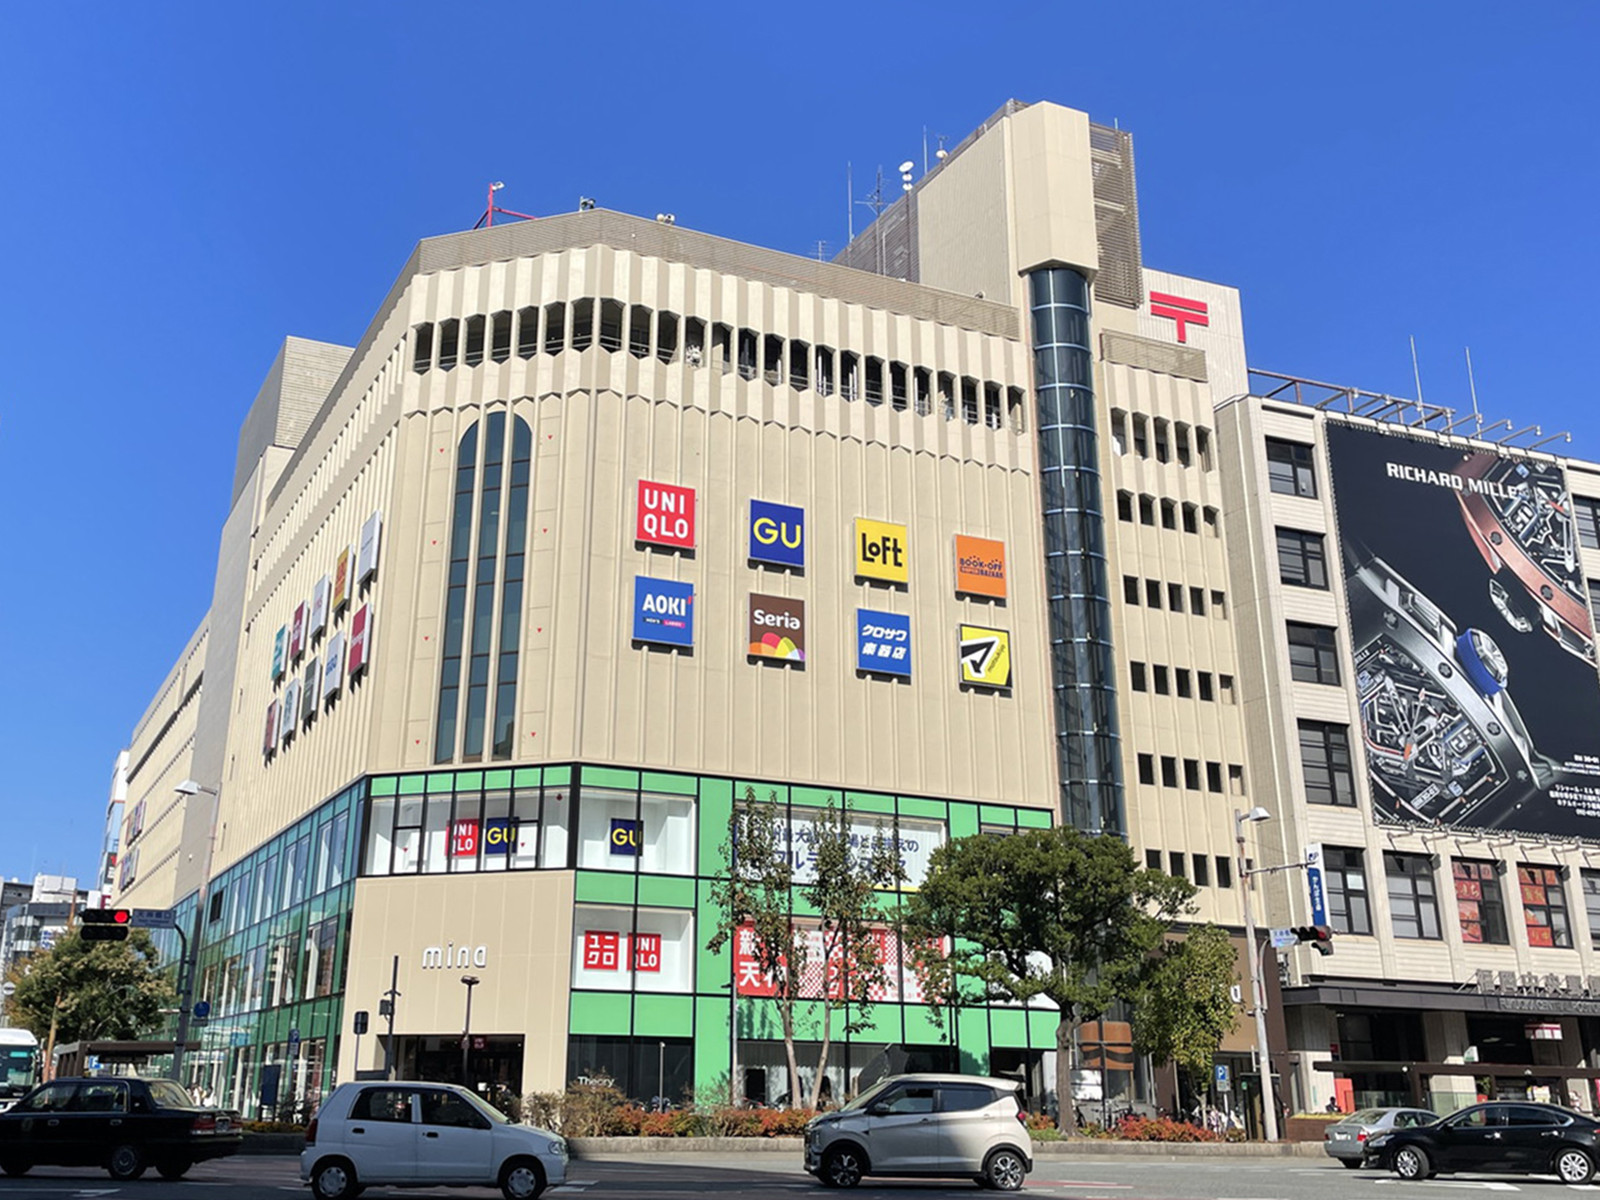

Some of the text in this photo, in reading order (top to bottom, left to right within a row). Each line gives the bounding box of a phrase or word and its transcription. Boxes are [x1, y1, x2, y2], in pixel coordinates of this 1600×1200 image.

[1386, 462, 1519, 499] RICHARD MILLE
[645, 488, 685, 515] UNI
[643, 513, 689, 539] QLO
[753, 517, 802, 549] GU
[642, 593, 686, 616] AOKI
[753, 608, 801, 630] Seria
[862, 623, 908, 642] クロサワ
[487, 827, 516, 845] GU
[589, 935, 615, 949] ユニ
[422, 941, 487, 969] mina
[587, 951, 615, 966] クロ
